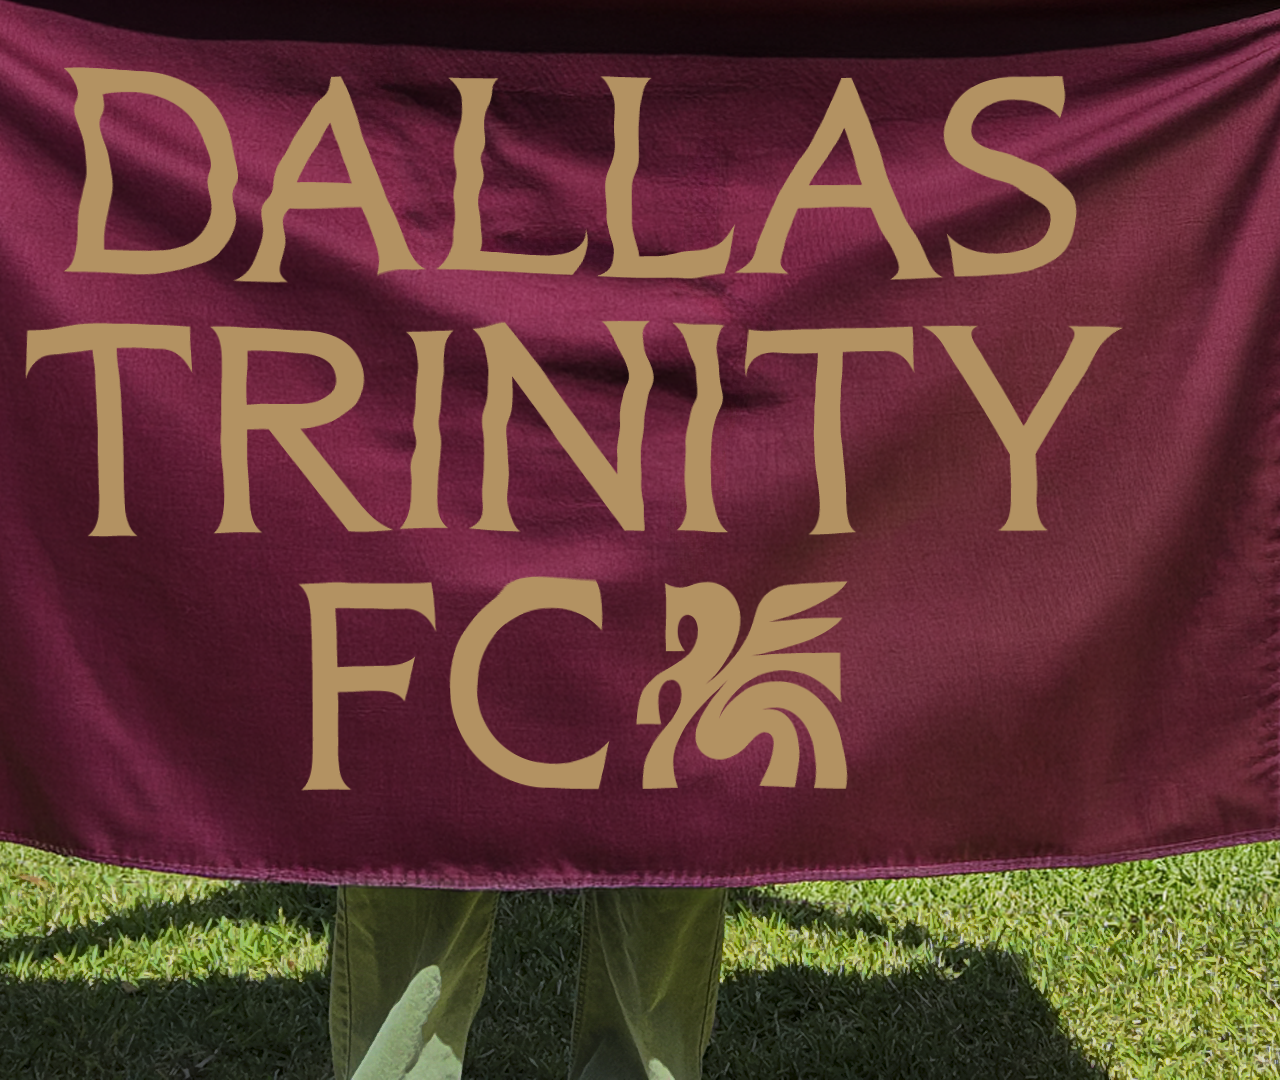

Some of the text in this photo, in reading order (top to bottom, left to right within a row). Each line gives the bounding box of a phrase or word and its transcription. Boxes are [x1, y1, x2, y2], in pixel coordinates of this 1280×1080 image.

[65, 68, 1076, 282] DALLAS
[26, 321, 1121, 536] TRINITY
[301, 577, 609, 790] FC
